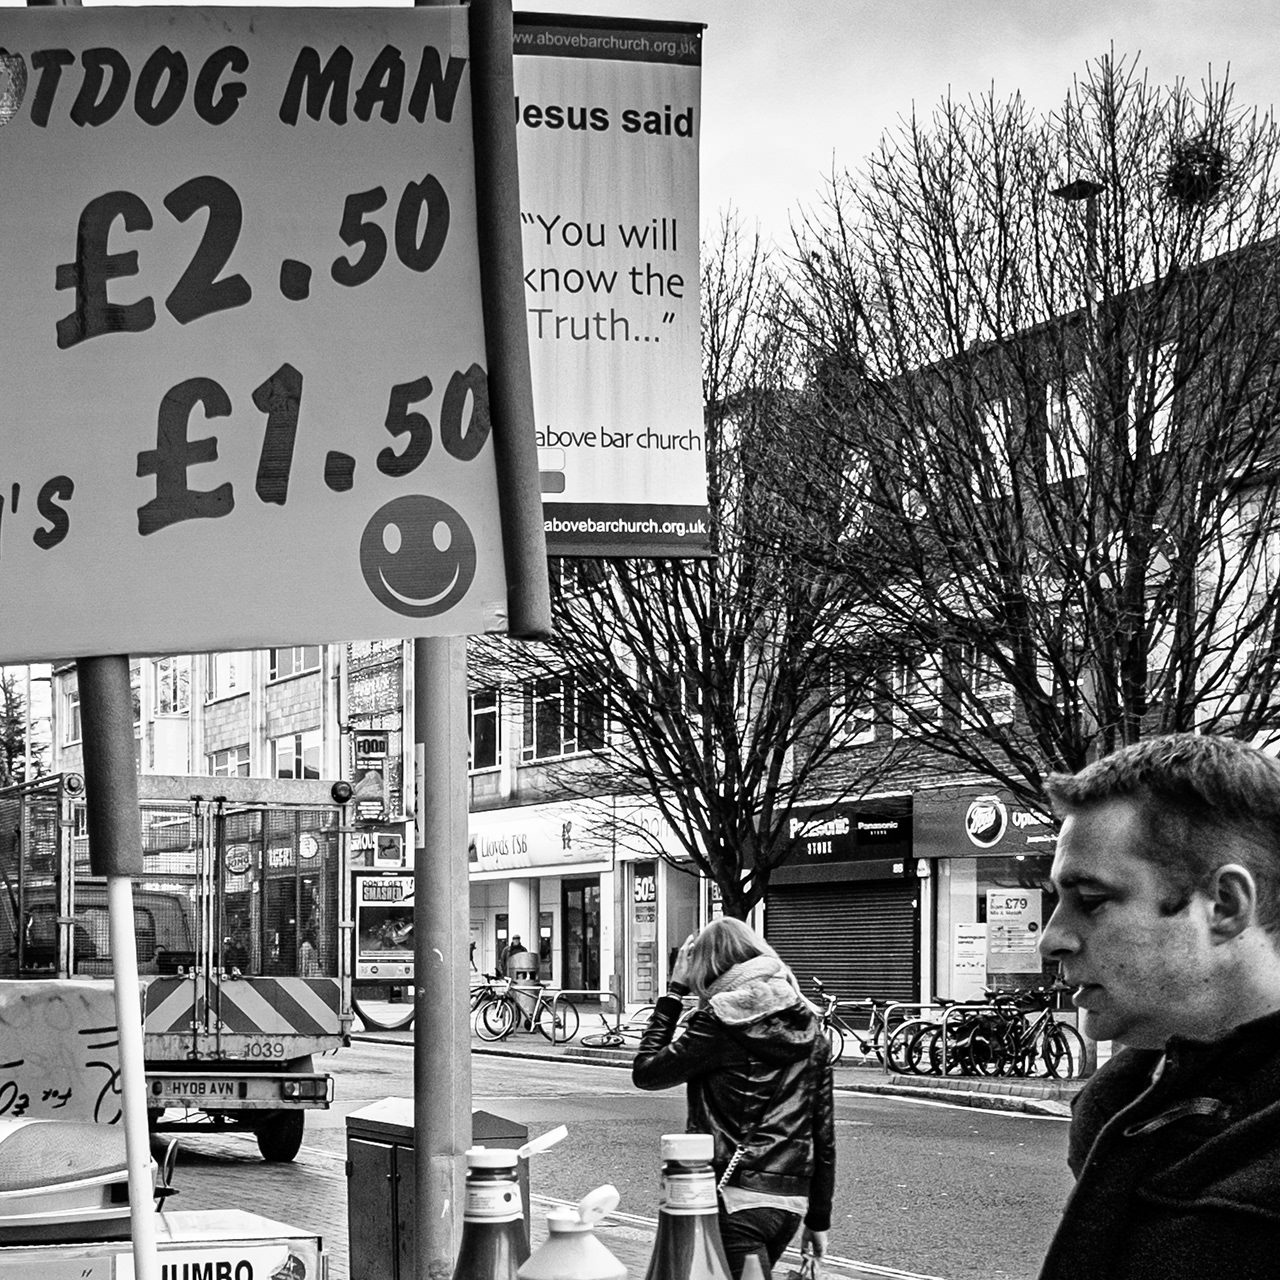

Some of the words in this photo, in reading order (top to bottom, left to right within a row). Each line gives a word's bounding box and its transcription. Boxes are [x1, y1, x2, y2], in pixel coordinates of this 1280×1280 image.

[280, 44, 466, 126] MAN
[621, 104, 694, 138] said
[618, 217, 677, 251] will
[56, 173, 451, 350] £2.50
[629, 262, 685, 299] the
[136, 362, 492, 537] £1.50
[536, 424, 596, 448] above
[601, 426, 634, 449] bar
[636, 427, 701, 451] church
[857, 820, 899, 831] Panasonic
[480, 835, 509, 864] Lloyds
[245, 1042, 286, 1058] 1039
[172, 1081, 206, 1095] HY08
[209, 1081, 234, 1095] AVN
